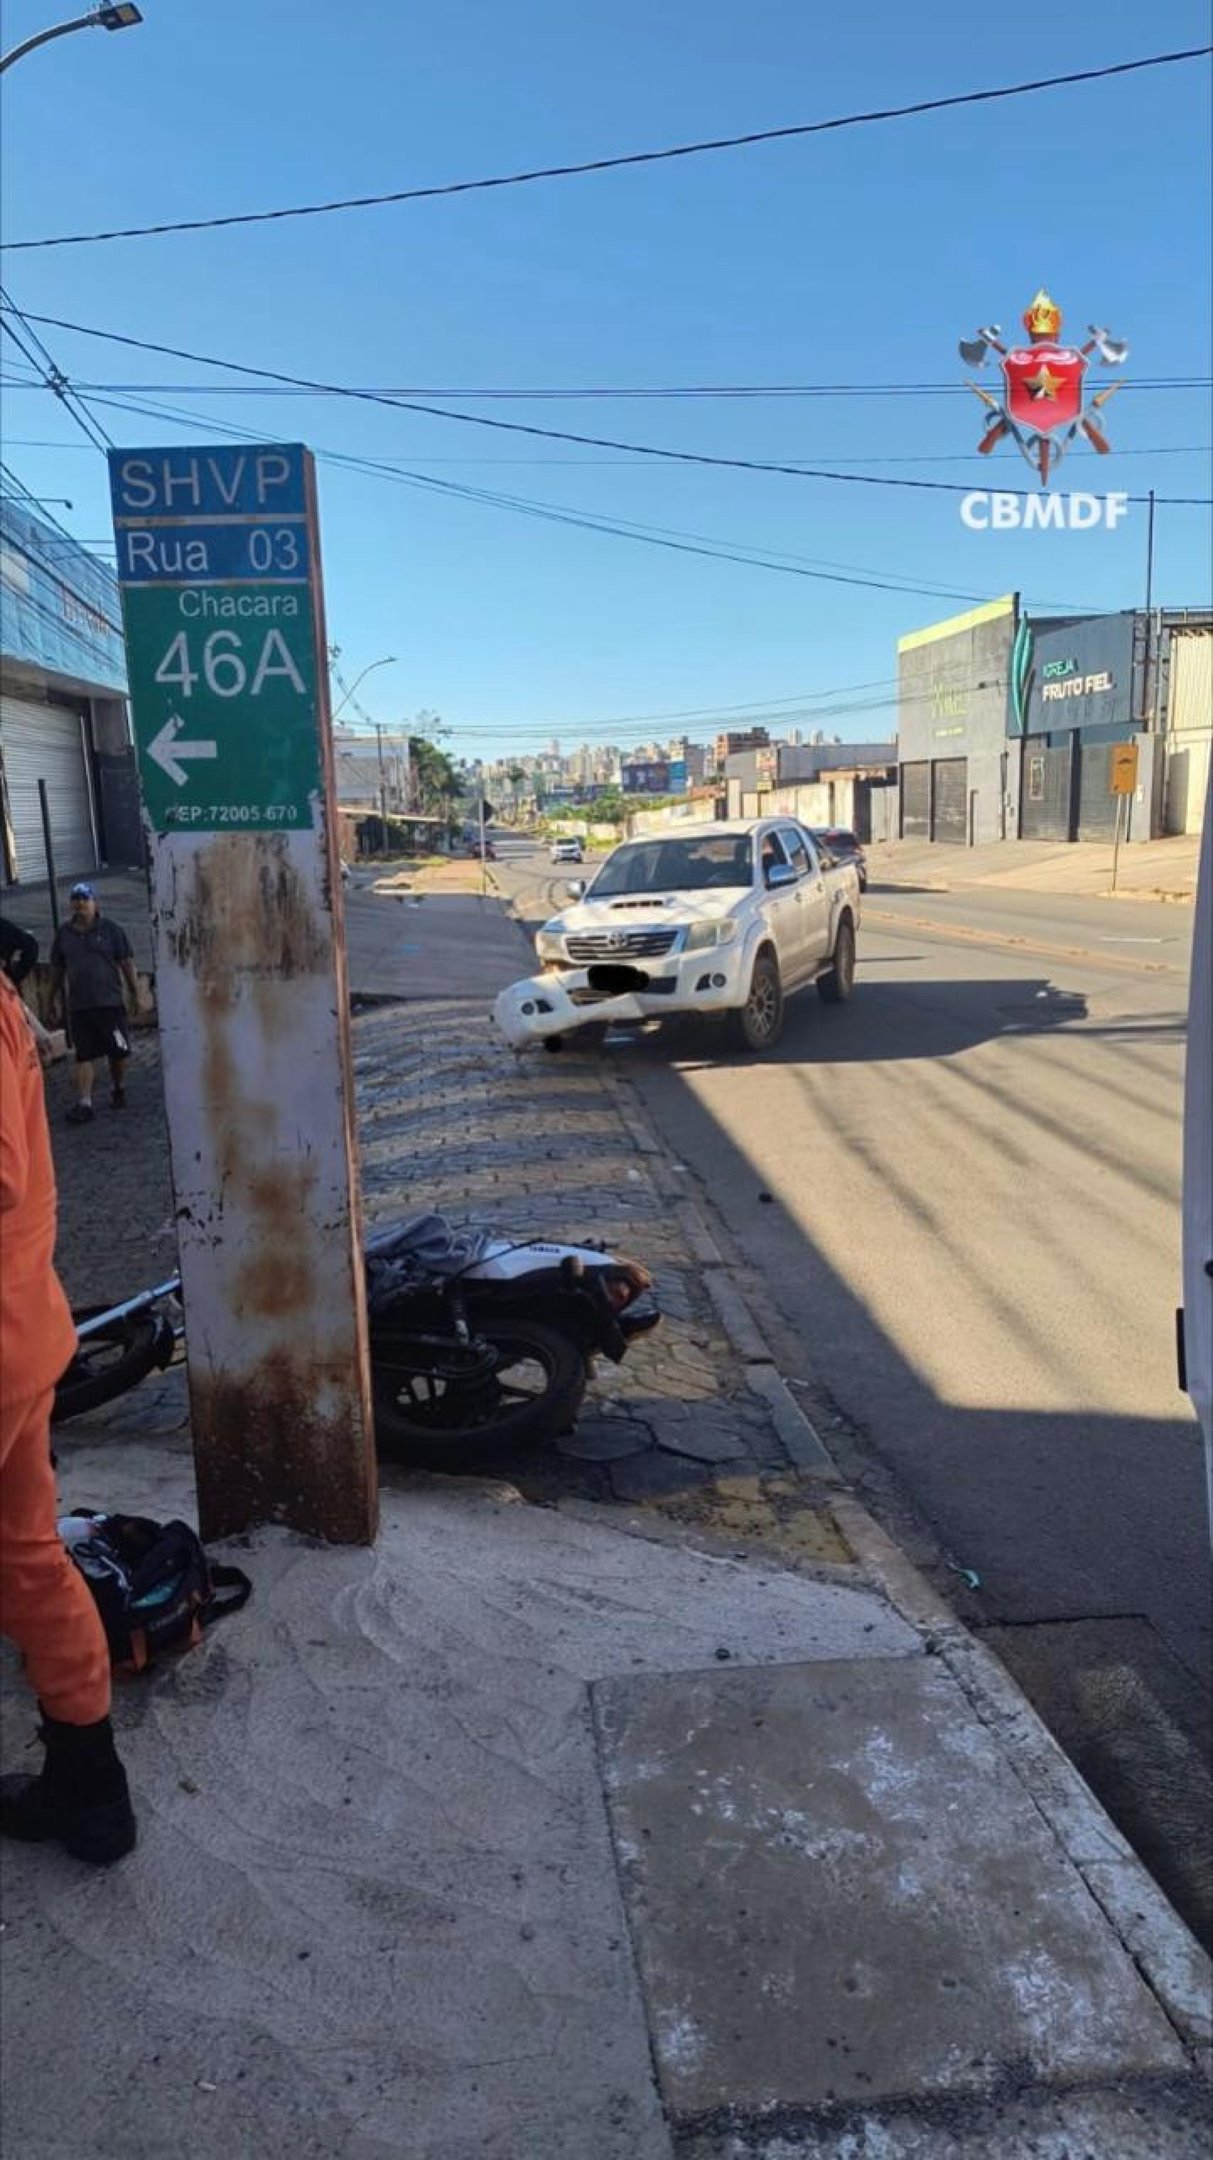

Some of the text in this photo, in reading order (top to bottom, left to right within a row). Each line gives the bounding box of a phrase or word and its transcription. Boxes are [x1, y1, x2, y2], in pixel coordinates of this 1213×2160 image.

[121, 455, 291, 508] SHVP
[127, 529, 298, 574] Rua 03
[178, 589, 298, 618] Chacara
[155, 628, 306, 697] 46A
[1042, 672, 1112, 701] FRUTO FIEL
